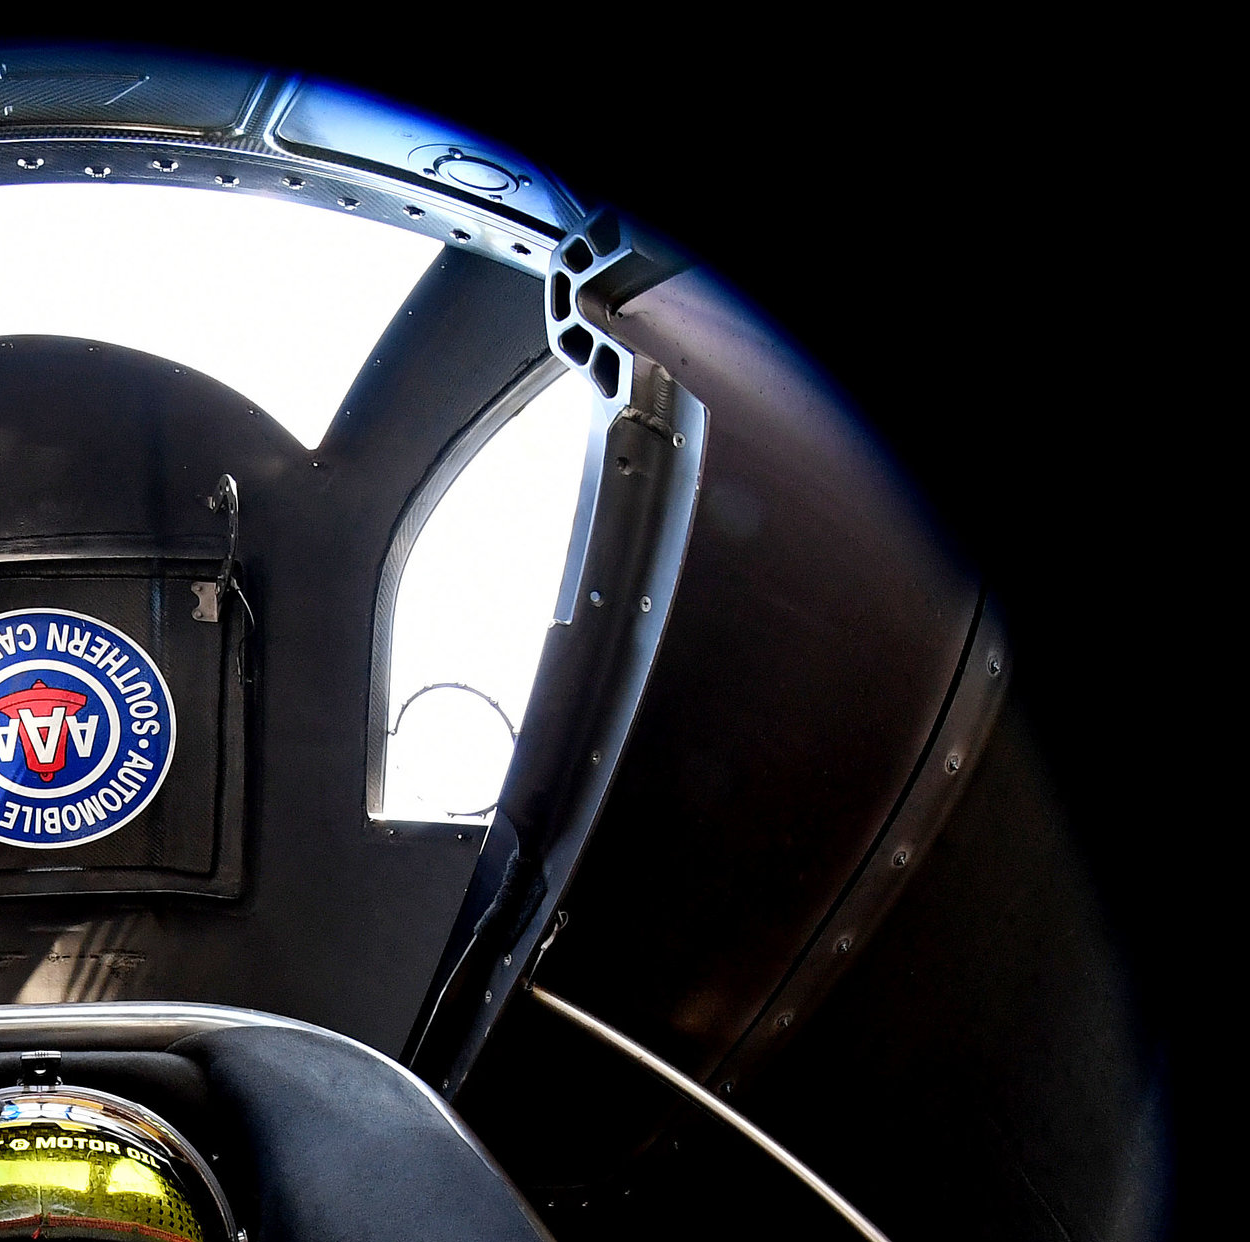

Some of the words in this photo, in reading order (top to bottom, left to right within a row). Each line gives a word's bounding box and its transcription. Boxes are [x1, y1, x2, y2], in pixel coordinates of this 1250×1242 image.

[46, 622, 160, 736] SOUTHERN
[0, 749, 154, 834] AUTOMOBILE
[35, 1136, 121, 1155] MOTOR
[126, 1146, 161, 1169] OIL
